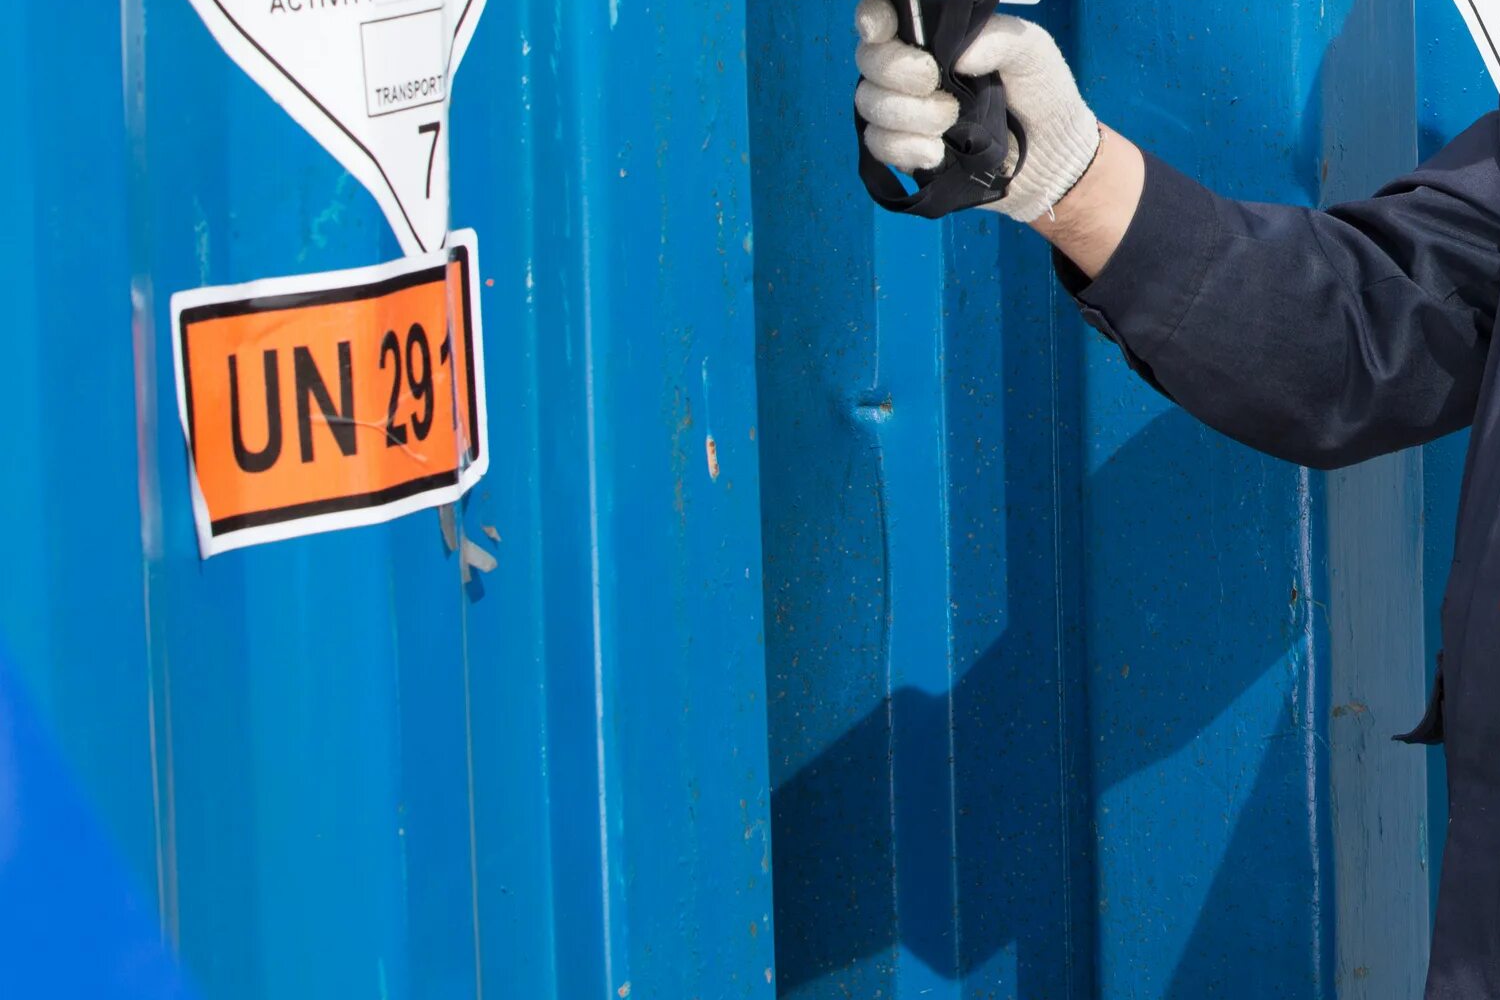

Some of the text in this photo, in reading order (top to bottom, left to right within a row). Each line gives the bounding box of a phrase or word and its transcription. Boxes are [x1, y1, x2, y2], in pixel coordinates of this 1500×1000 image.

[376, 74, 443, 107] TRANSPORT
[418, 121, 441, 200] 7
[228, 340, 358, 474] UN
